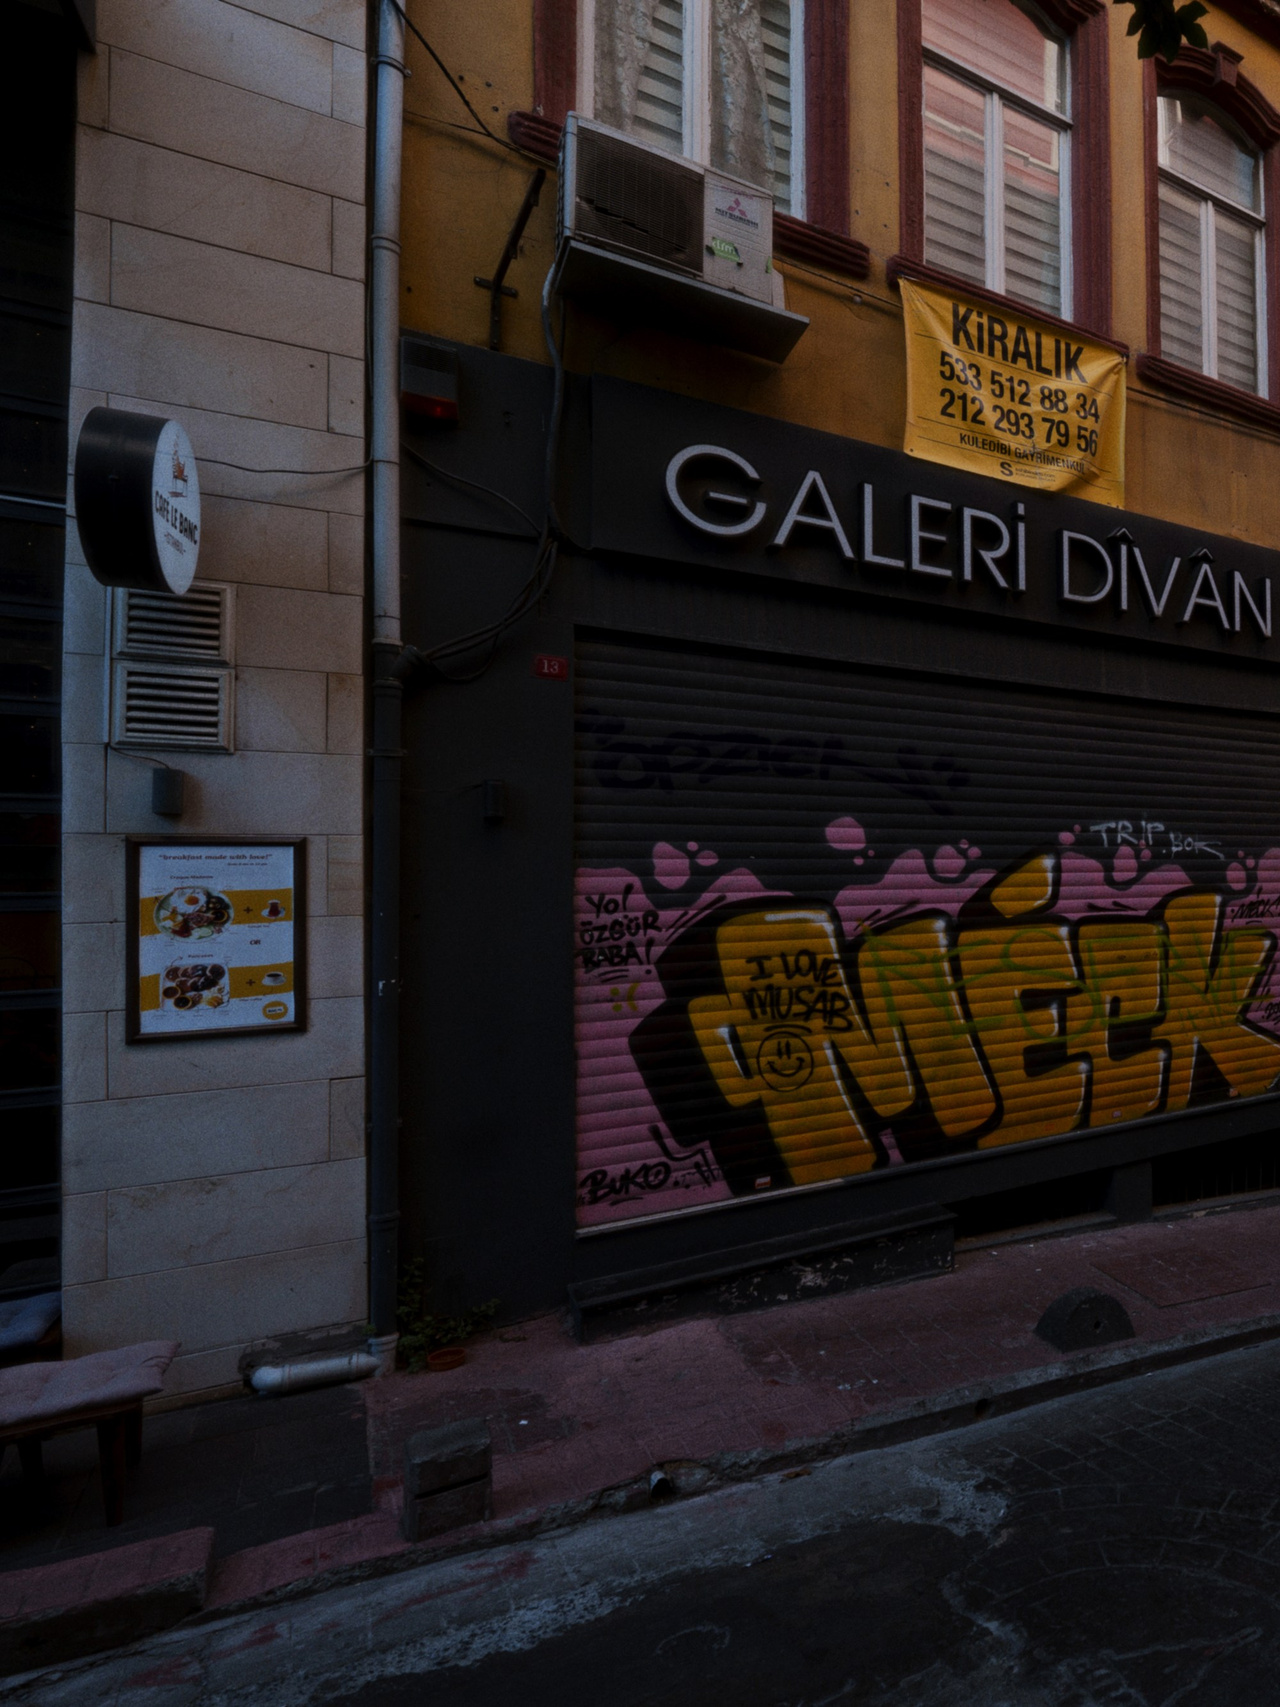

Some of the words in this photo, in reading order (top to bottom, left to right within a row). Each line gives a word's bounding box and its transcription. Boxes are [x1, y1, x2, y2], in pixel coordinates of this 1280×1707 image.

[940, 351, 982, 391] 533
[991, 371, 1031, 406] 512
[1040, 385, 1068, 414] 88
[1076, 393, 1099, 423] 34
[940, 388, 985, 426] 212
[991, 405, 1035, 440] 293
[1042, 417, 1069, 447] 79
[1076, 425, 1098, 457] 56
[171, 504, 178, 530] LE
[179, 511, 198, 545] BANC
[542, 659, 559, 674] 13
[746, 955, 774, 981] I
[780, 949, 846, 986] LOVE
